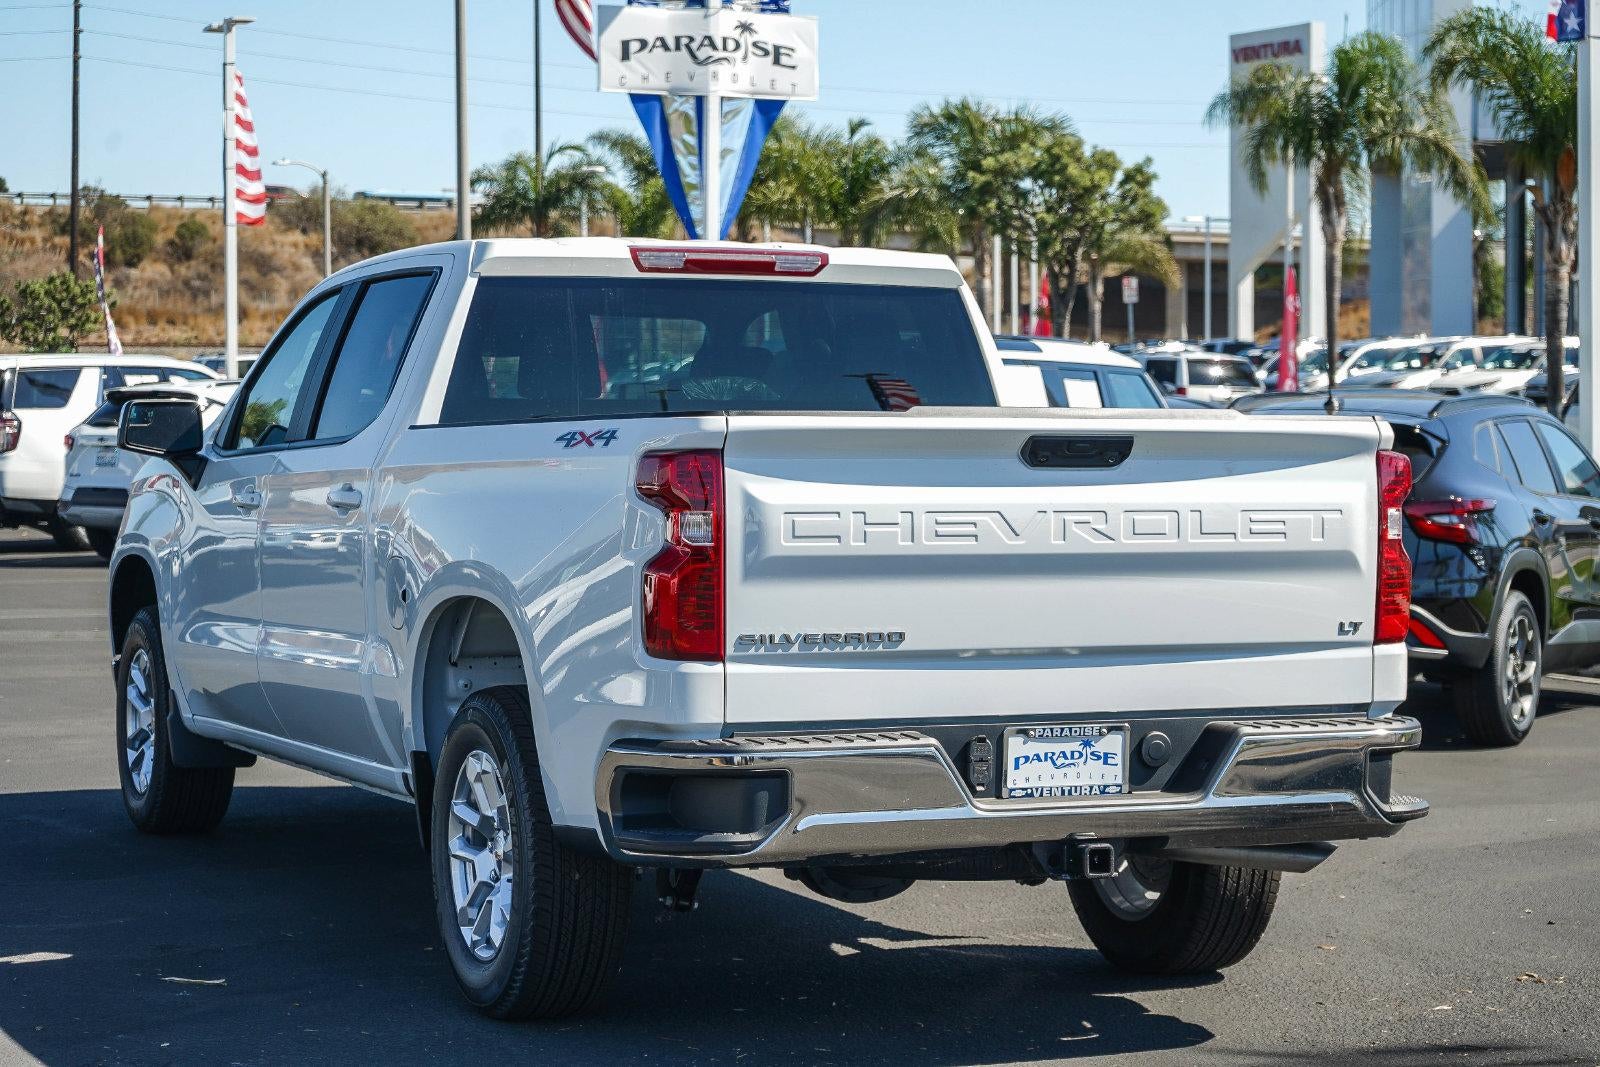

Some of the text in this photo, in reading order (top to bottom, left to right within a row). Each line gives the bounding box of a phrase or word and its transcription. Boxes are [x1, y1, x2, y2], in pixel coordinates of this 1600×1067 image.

[620, 20, 798, 70] PARADISE
[1232, 39, 1304, 63] VENTURA
[618, 71, 798, 94] CHEVROLET
[781, 509, 1343, 546] CHEVROLET
[1339, 621, 1364, 634] LT
[737, 631, 906, 646] SILVERADO
[1035, 726, 1100, 738] PARADISE
[1013, 738, 1119, 770] PARADISE
[1013, 772, 1118, 786] CHEVROLET
[1032, 785, 1101, 798] VENTURA
